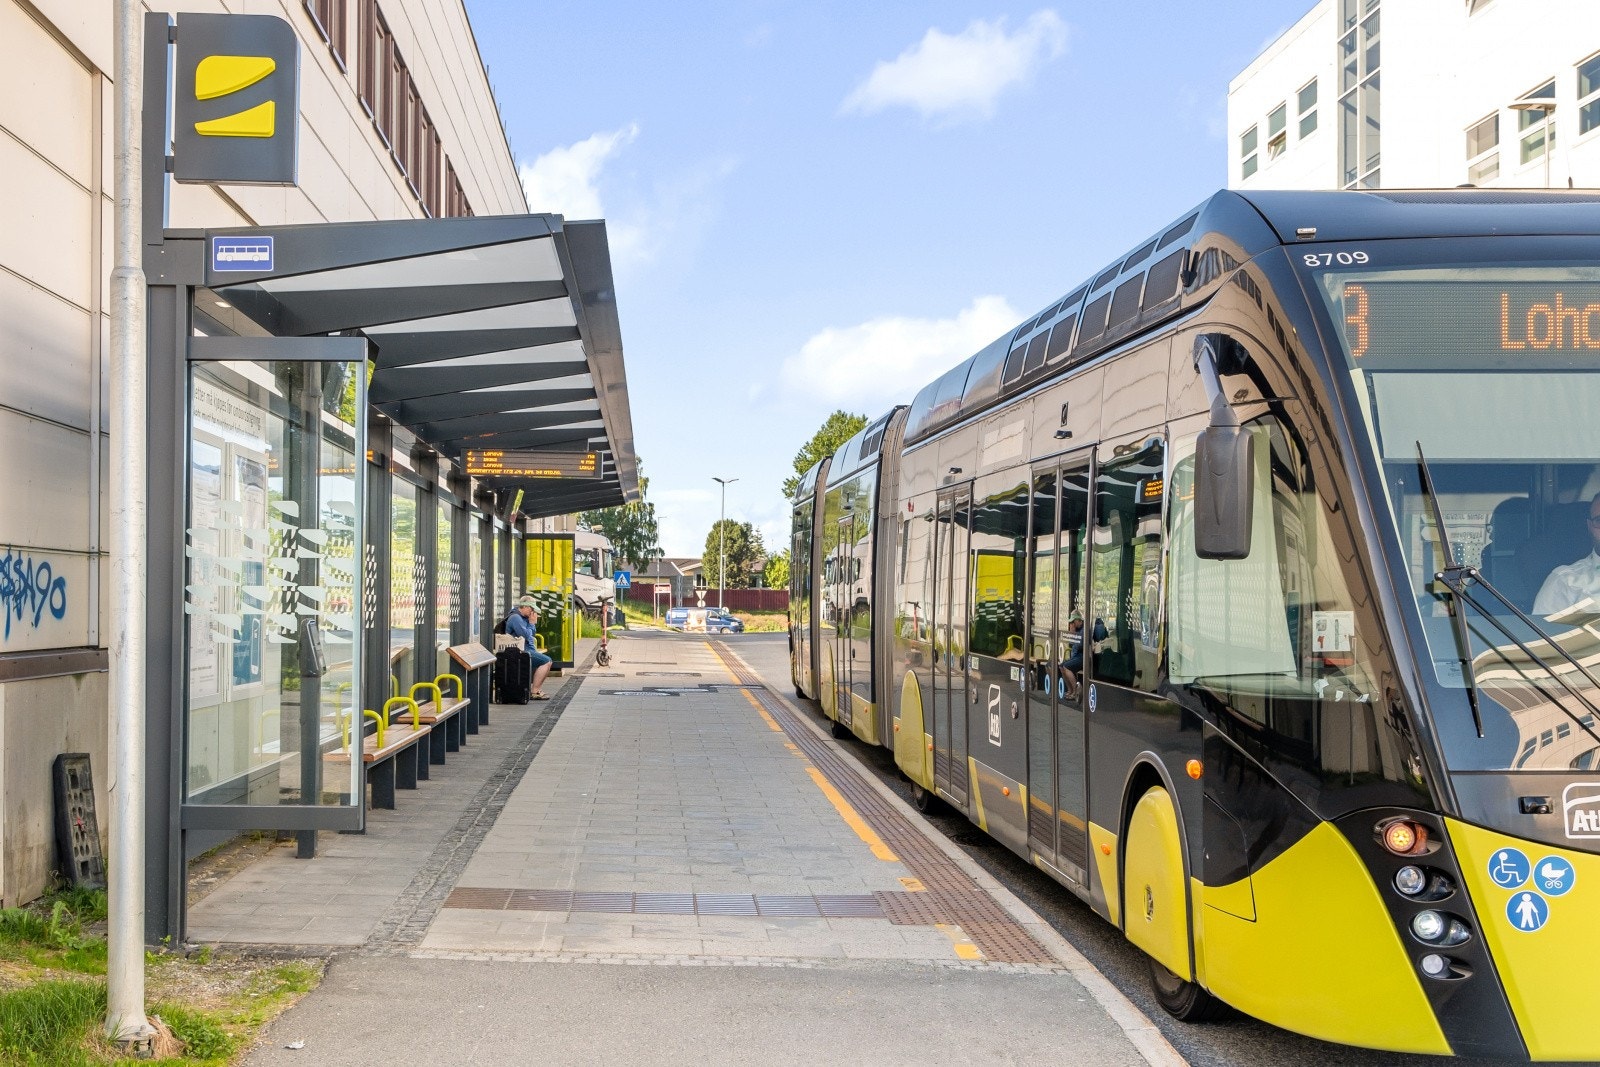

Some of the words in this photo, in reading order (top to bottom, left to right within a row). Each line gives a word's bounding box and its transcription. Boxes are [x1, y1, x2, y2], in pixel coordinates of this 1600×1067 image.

[1303, 250, 1370, 268] 8709
[1344, 285, 1369, 358] 3
[1572, 809, 1600, 831] At
